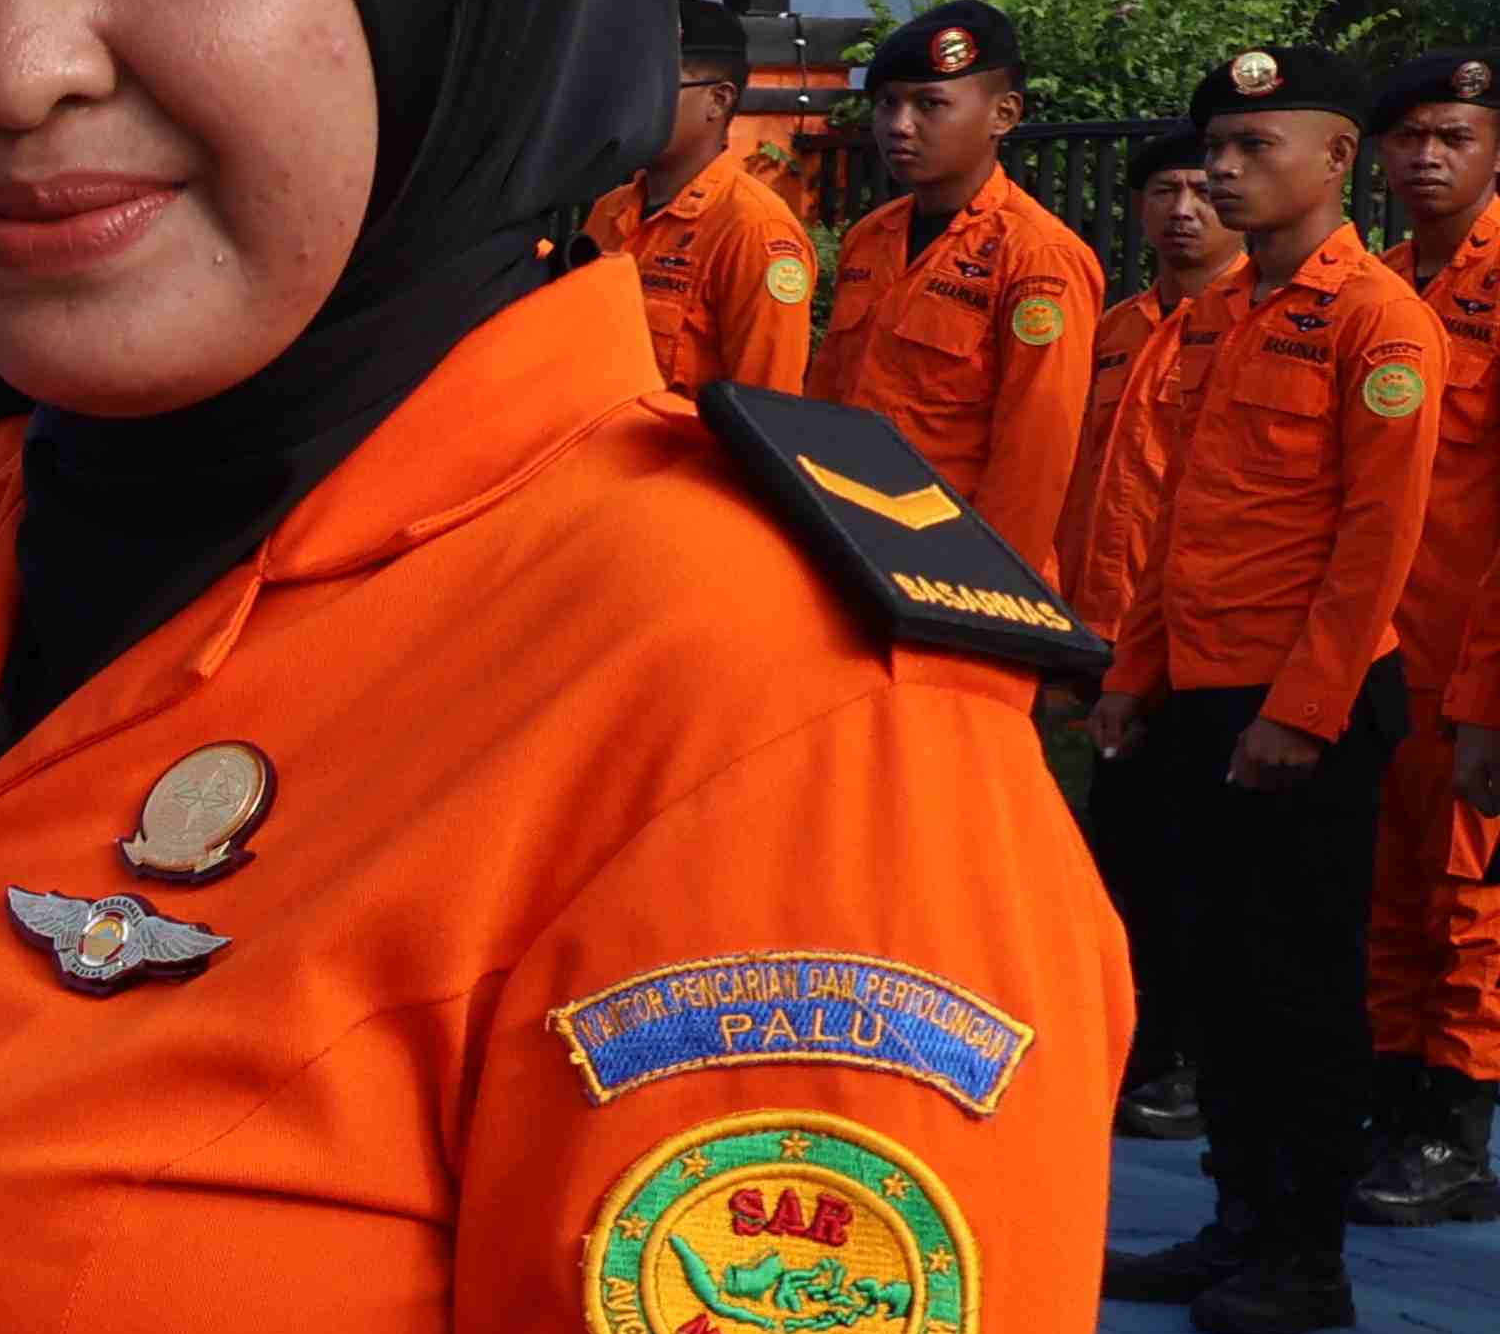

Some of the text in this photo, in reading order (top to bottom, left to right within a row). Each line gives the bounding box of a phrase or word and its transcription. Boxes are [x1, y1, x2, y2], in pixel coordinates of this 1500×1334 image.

[891, 571, 1073, 633] BASARNAS
[580, 964, 1011, 1060] KANTOR PENCARIAN DAN PERTOLONGAN
[719, 1007, 884, 1051] PALU
[728, 1188, 856, 1247] SAR
